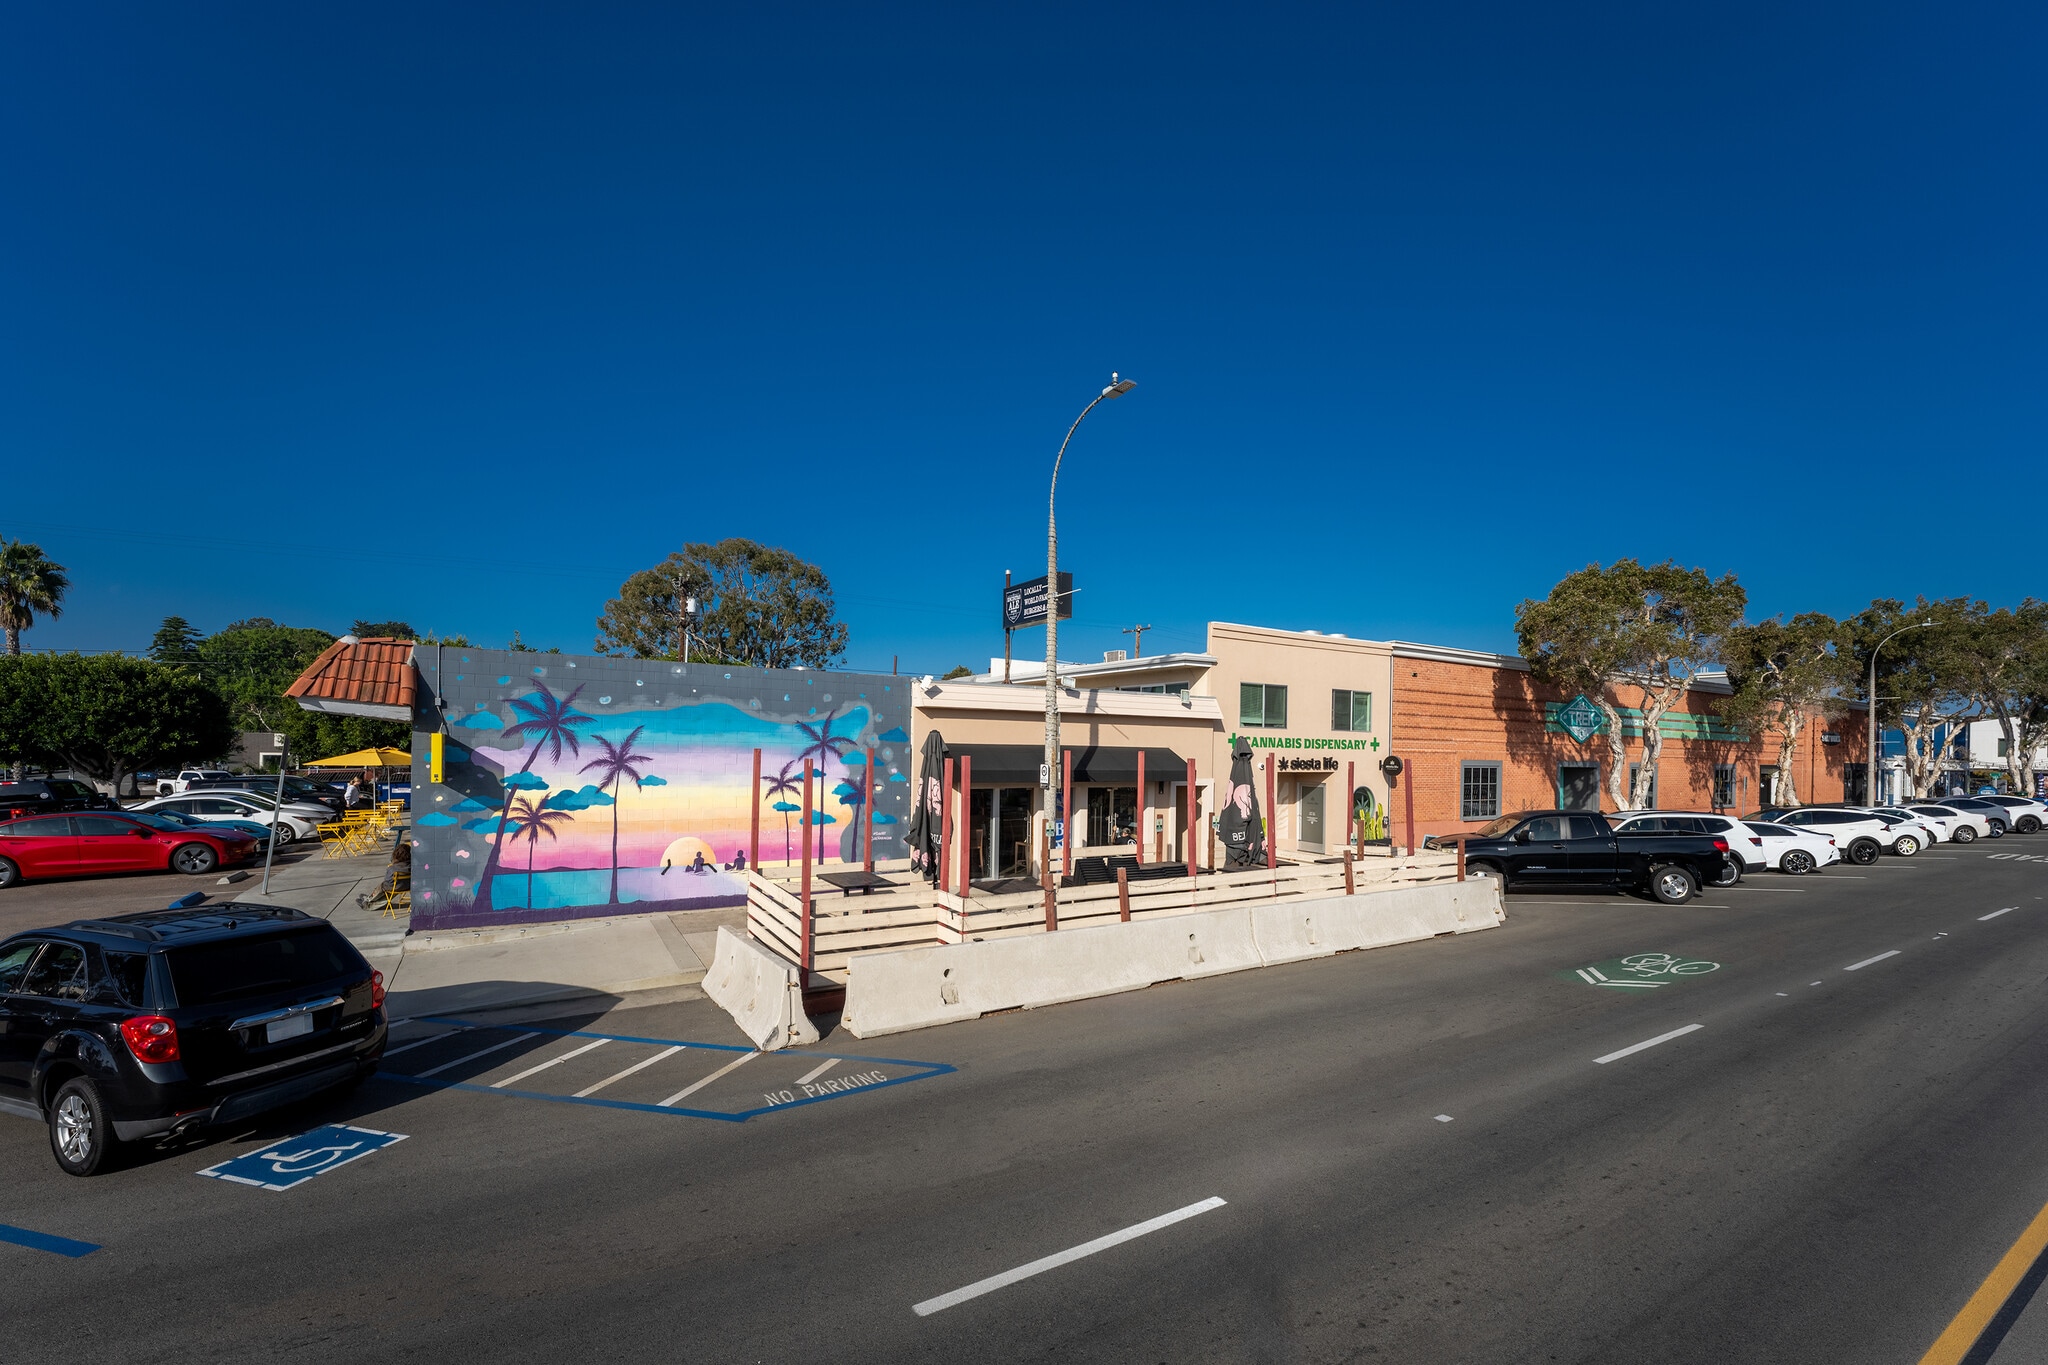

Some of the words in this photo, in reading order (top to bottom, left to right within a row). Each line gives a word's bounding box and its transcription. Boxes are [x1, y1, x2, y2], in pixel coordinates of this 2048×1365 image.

[1568, 711, 1595, 726] TREK
[1304, 738, 1367, 750] DISPENSARY
[1290, 757, 1321, 771] siesta
[1323, 757, 1339, 771] life
[763, 1090, 795, 1106] NO
[802, 1070, 887, 1098] PARKING
